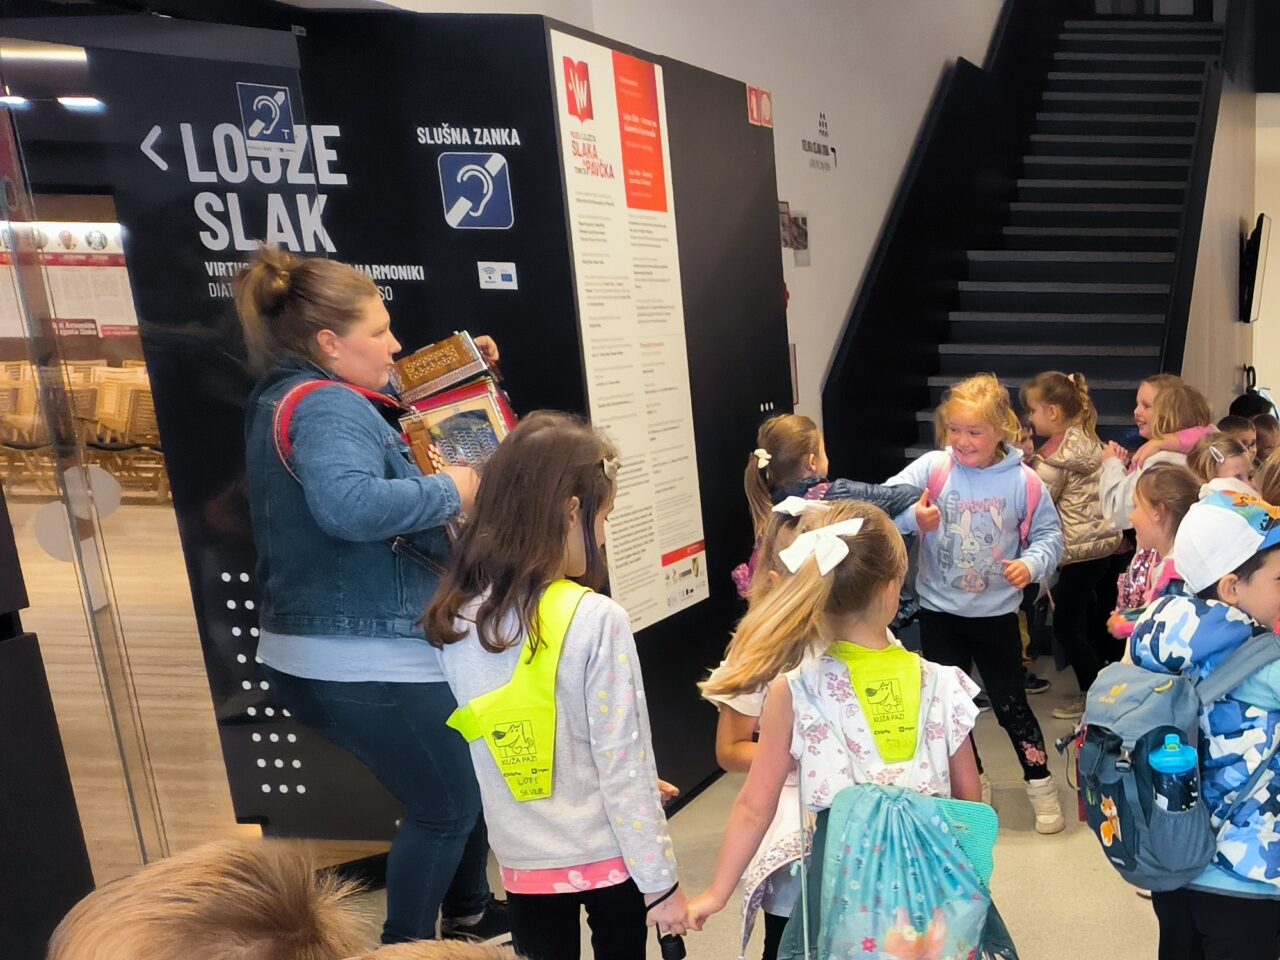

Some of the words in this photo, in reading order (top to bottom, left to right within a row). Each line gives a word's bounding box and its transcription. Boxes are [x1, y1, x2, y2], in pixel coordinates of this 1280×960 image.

[416, 122, 472, 145] SLUŠNA
[473, 127, 521, 146] ZANKA
[193, 191, 337, 253] SLAK
